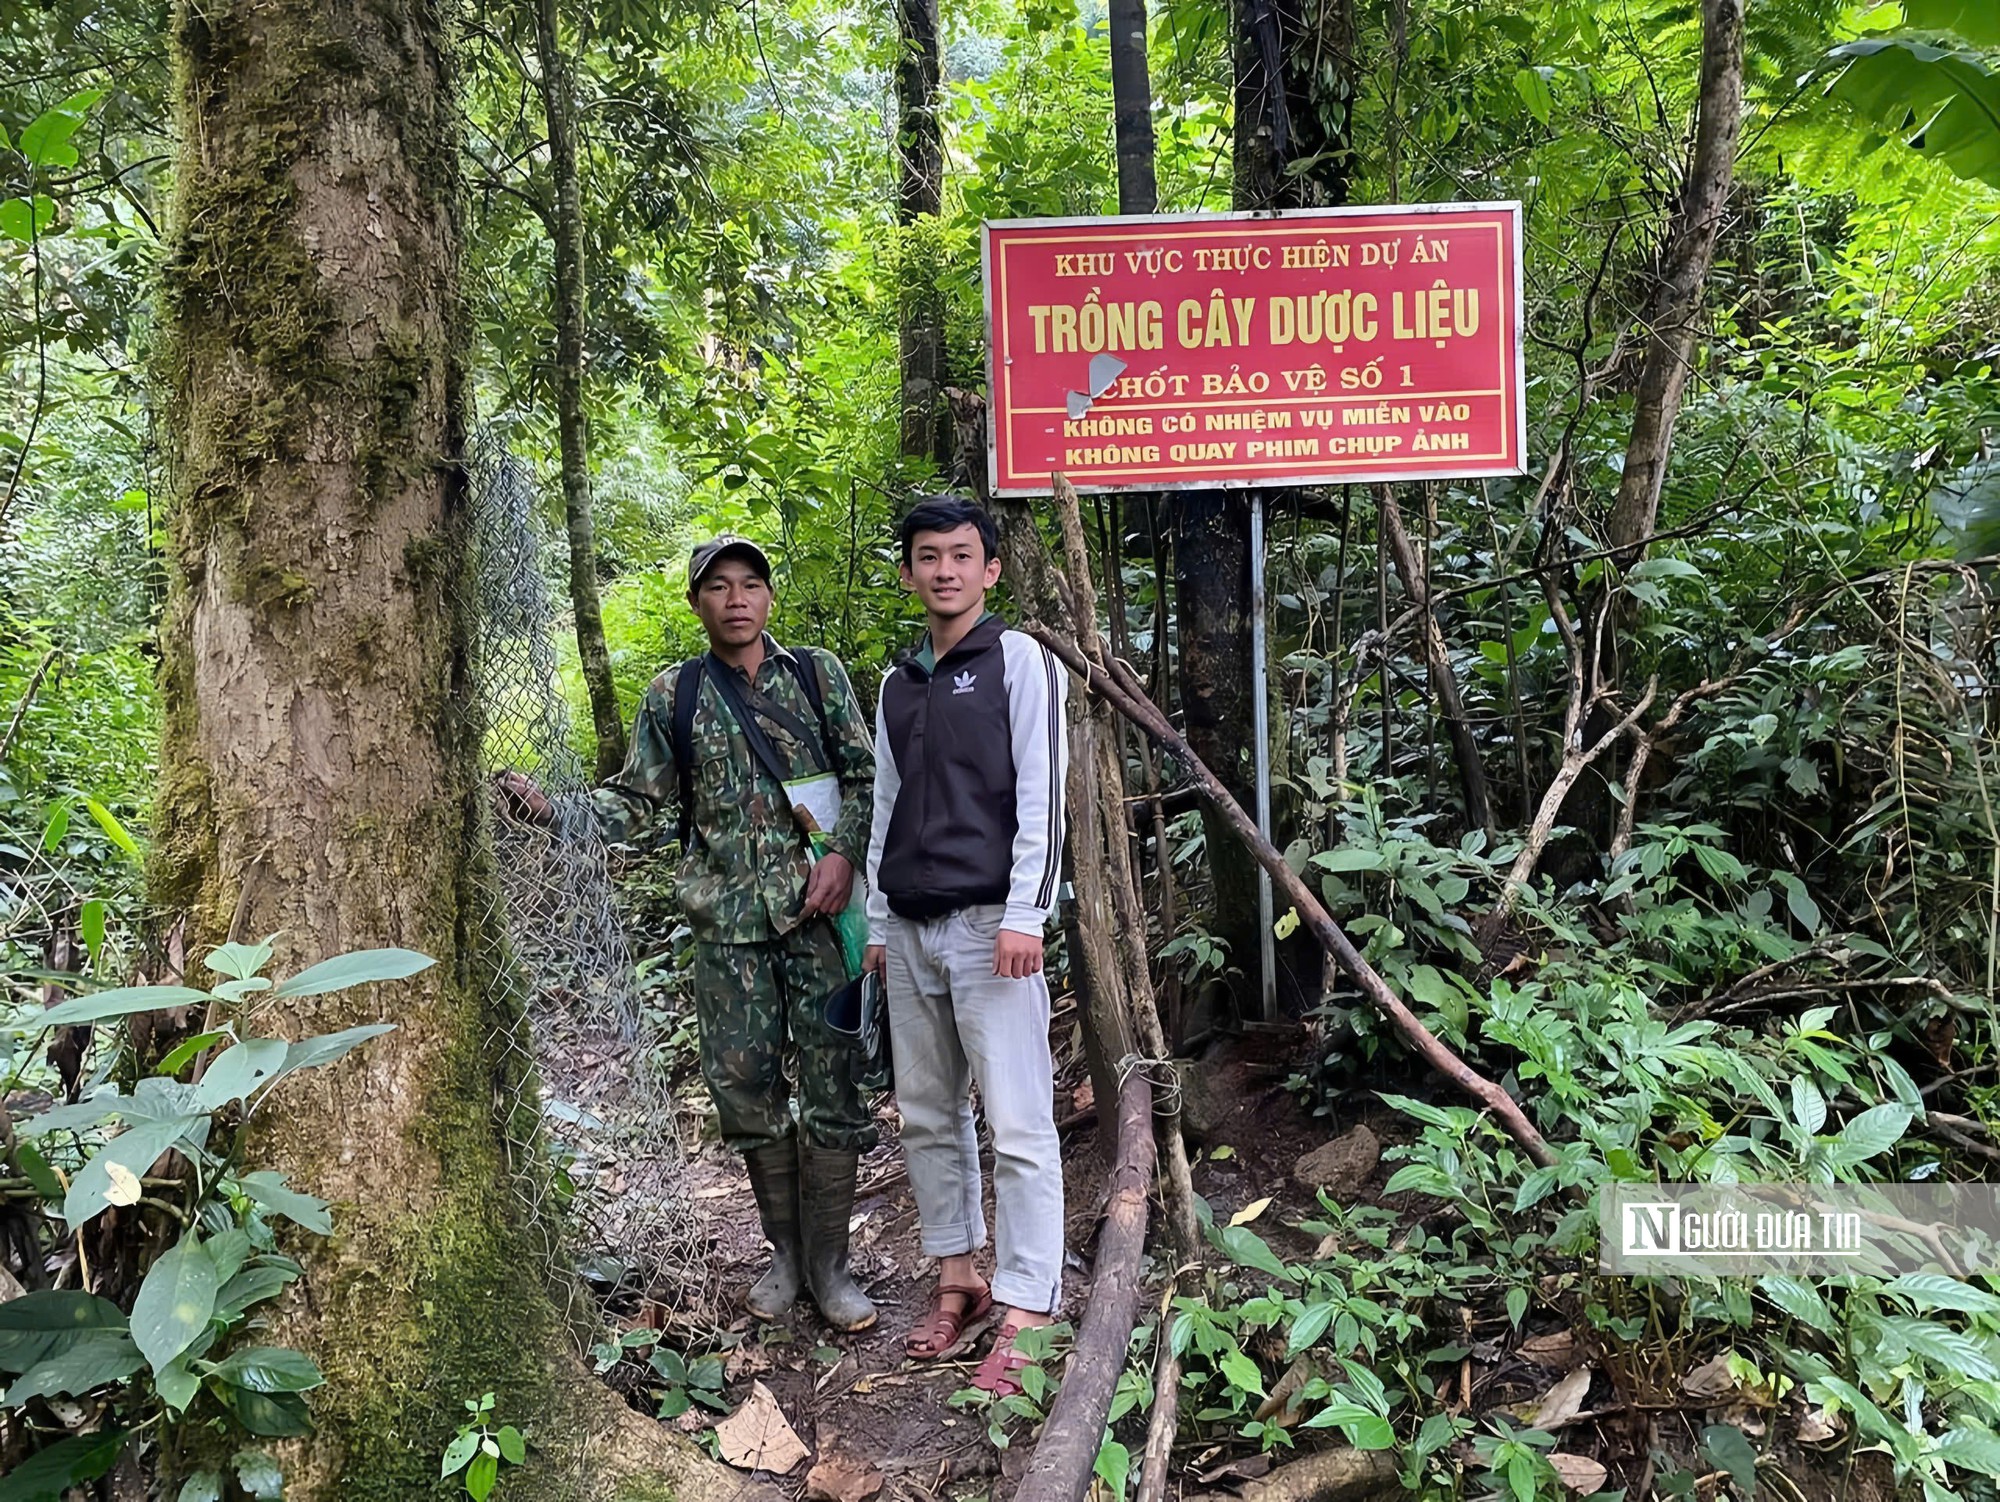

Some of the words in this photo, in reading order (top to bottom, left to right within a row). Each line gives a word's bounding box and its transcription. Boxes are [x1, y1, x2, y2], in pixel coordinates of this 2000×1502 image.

[1055, 252, 1115, 277] KHU
[1124, 247, 1183, 279] VỰC
[1193, 243, 1271, 275] THỰC
[1281, 239, 1350, 273] HIỆN
[1360, 237, 1401, 270] DỰ
[1409, 234, 1449, 263] ÁN
[1028, 286, 1164, 354] TRỒNG
[1177, 287, 1256, 349] CÂY
[1269, 289, 1378, 354] DƯỢC
[1392, 278, 1479, 349] LIỆU
[1201, 363, 1270, 396] BẢO
[1281, 363, 1327, 396] VỆ
[1340, 355, 1385, 390] SỐ
[1399, 365, 1415, 387] 1
[1063, 415, 1153, 438] KHÔNG
[1161, 411, 1196, 434] CÓ
[1205, 409, 1291, 434] NHIỆM
[1299, 409, 1334, 430] VỤ
[1342, 401, 1411, 426] MIỄN
[1418, 401, 1471, 423] VÀO
[1065, 443, 1160, 466] KHÔNG
[1169, 441, 1237, 463] QUAY
[1246, 438, 1319, 458] PHIM
[1328, 434, 1403, 457] CHỤP
[1411, 428, 1470, 451] ẢNH
